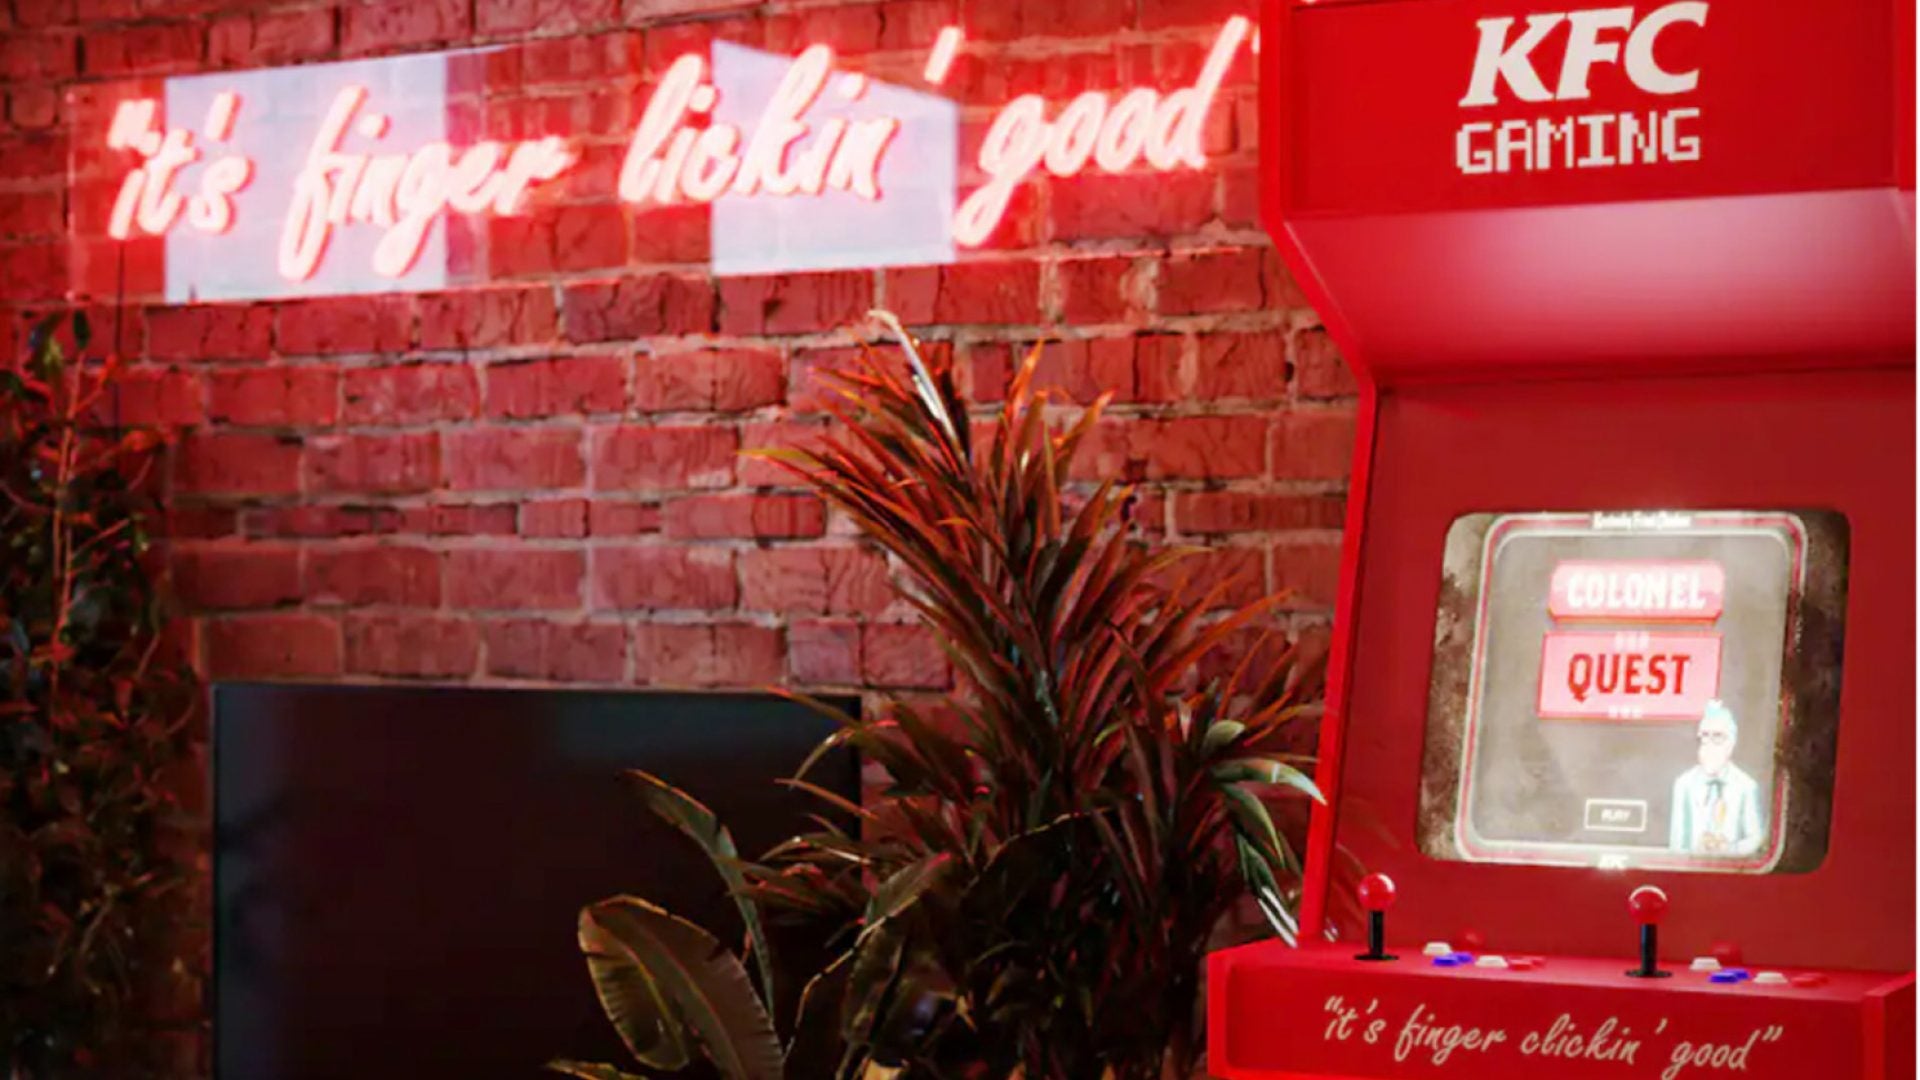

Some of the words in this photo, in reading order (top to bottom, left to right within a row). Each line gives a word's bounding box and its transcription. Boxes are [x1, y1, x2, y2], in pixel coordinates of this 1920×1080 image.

[1458, 2, 1710, 107] KFC
[1456, 107, 1700, 174] GAMING
[278, 86, 581, 281] finger
[1567, 570, 1706, 609] COLONEL
[1568, 653, 1691, 703] QUEST
[1394, 1003, 1507, 1066] finger
